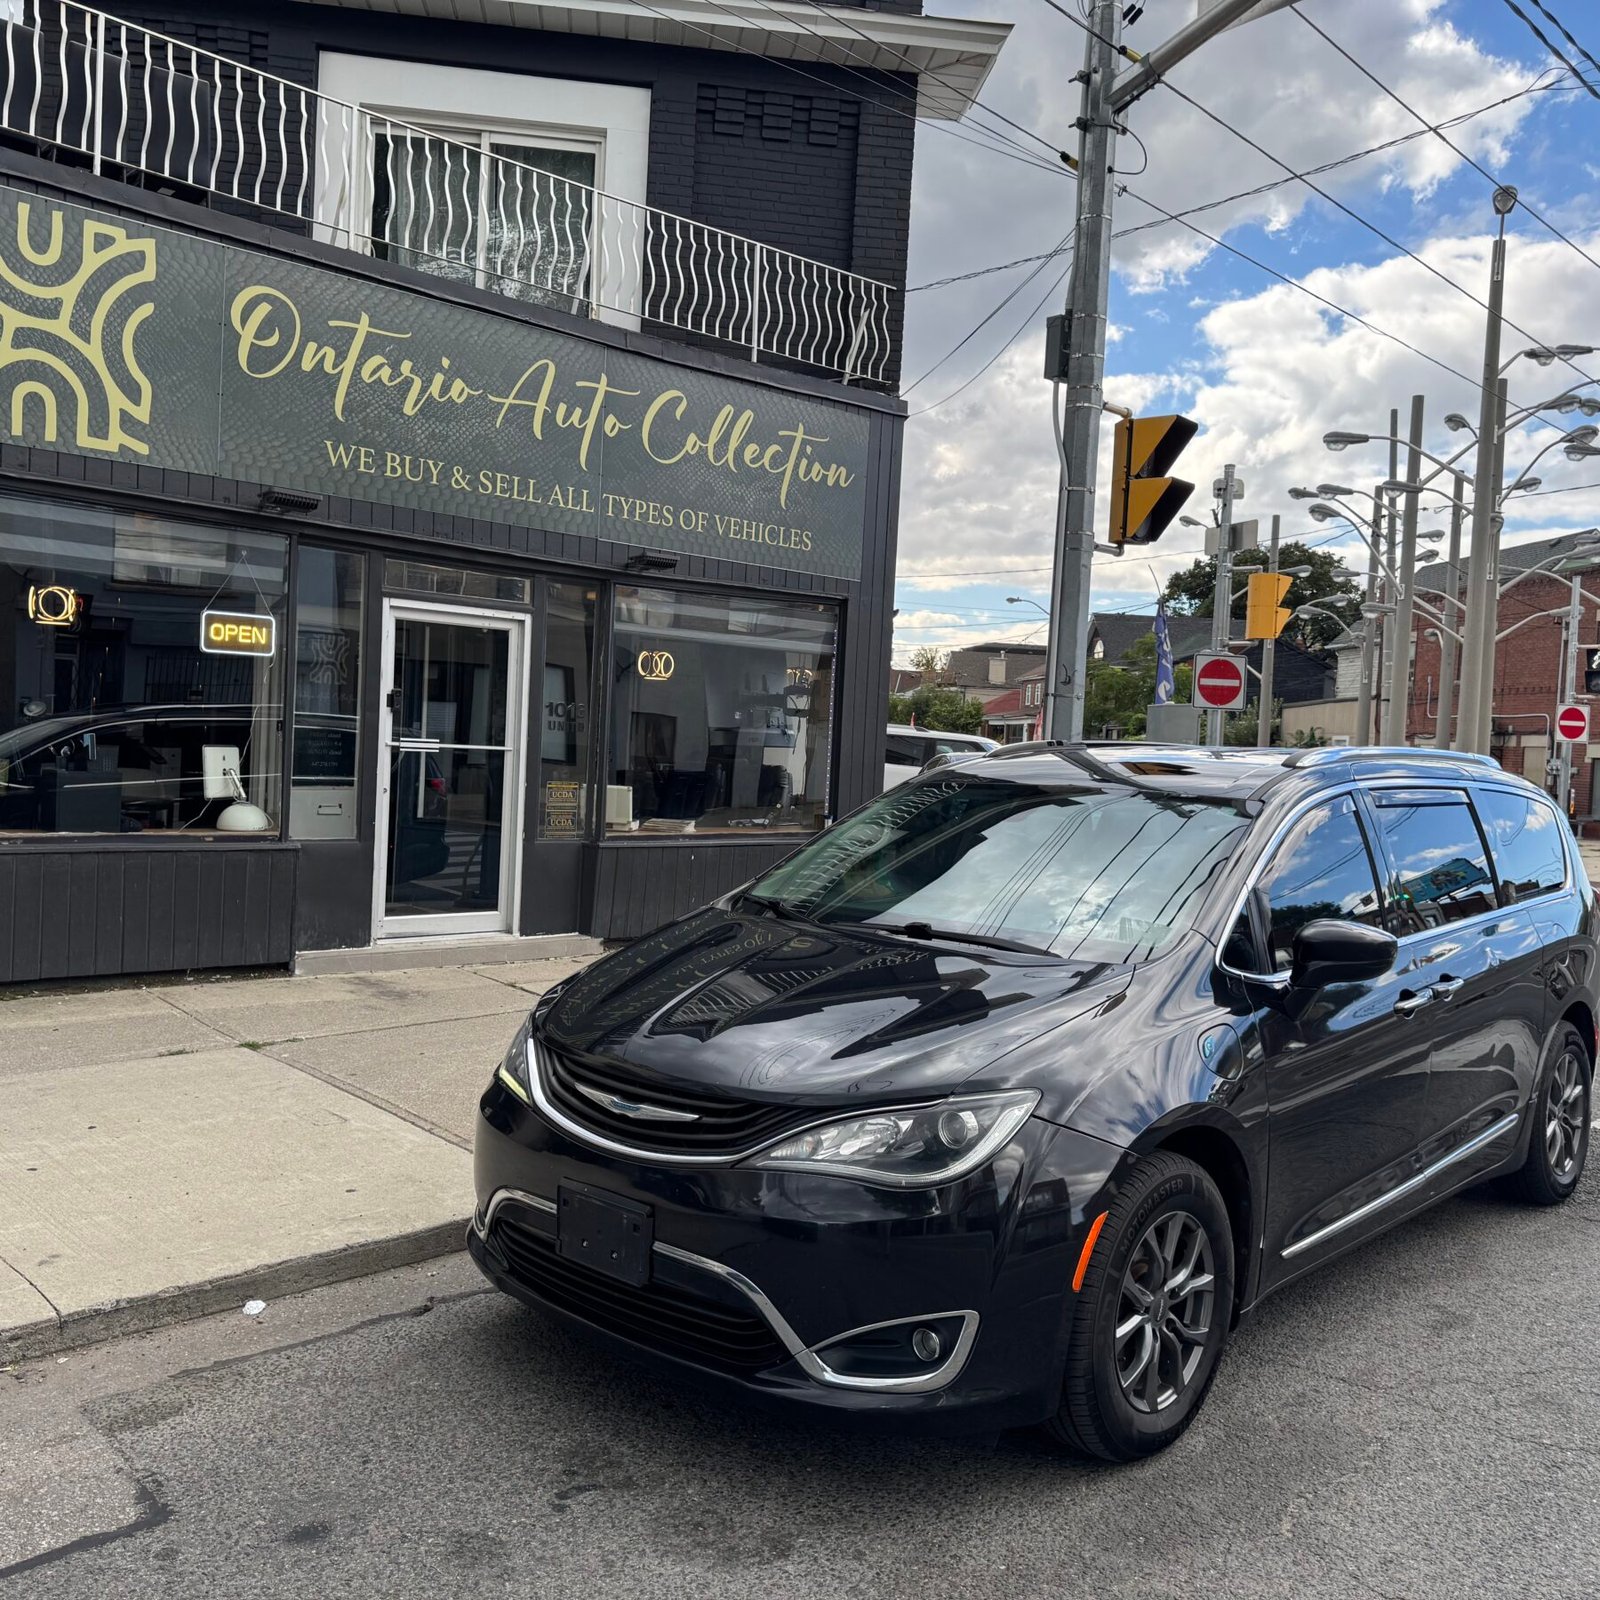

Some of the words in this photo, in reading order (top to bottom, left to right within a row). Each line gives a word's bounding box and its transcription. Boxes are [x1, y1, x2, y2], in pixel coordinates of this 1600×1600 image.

[230, 285, 483, 422] Ontario
[487, 359, 641, 472] Auto
[642, 389, 855, 510] Collection
[324, 440, 376, 473] WE
[384, 451, 445, 485] BUY
[451, 465, 472, 491] &
[478, 470, 542, 503] SELL
[547, 484, 595, 513] ALL
[602, 493, 673, 527] TYPES
[679, 508, 709, 532] OF
[714, 514, 812, 551] VEHICLES
[210, 622, 267, 645] OPEN
[550, 818, 573, 826] UCDA
[1120, 1178, 1184, 1255] MOTOMASTER
